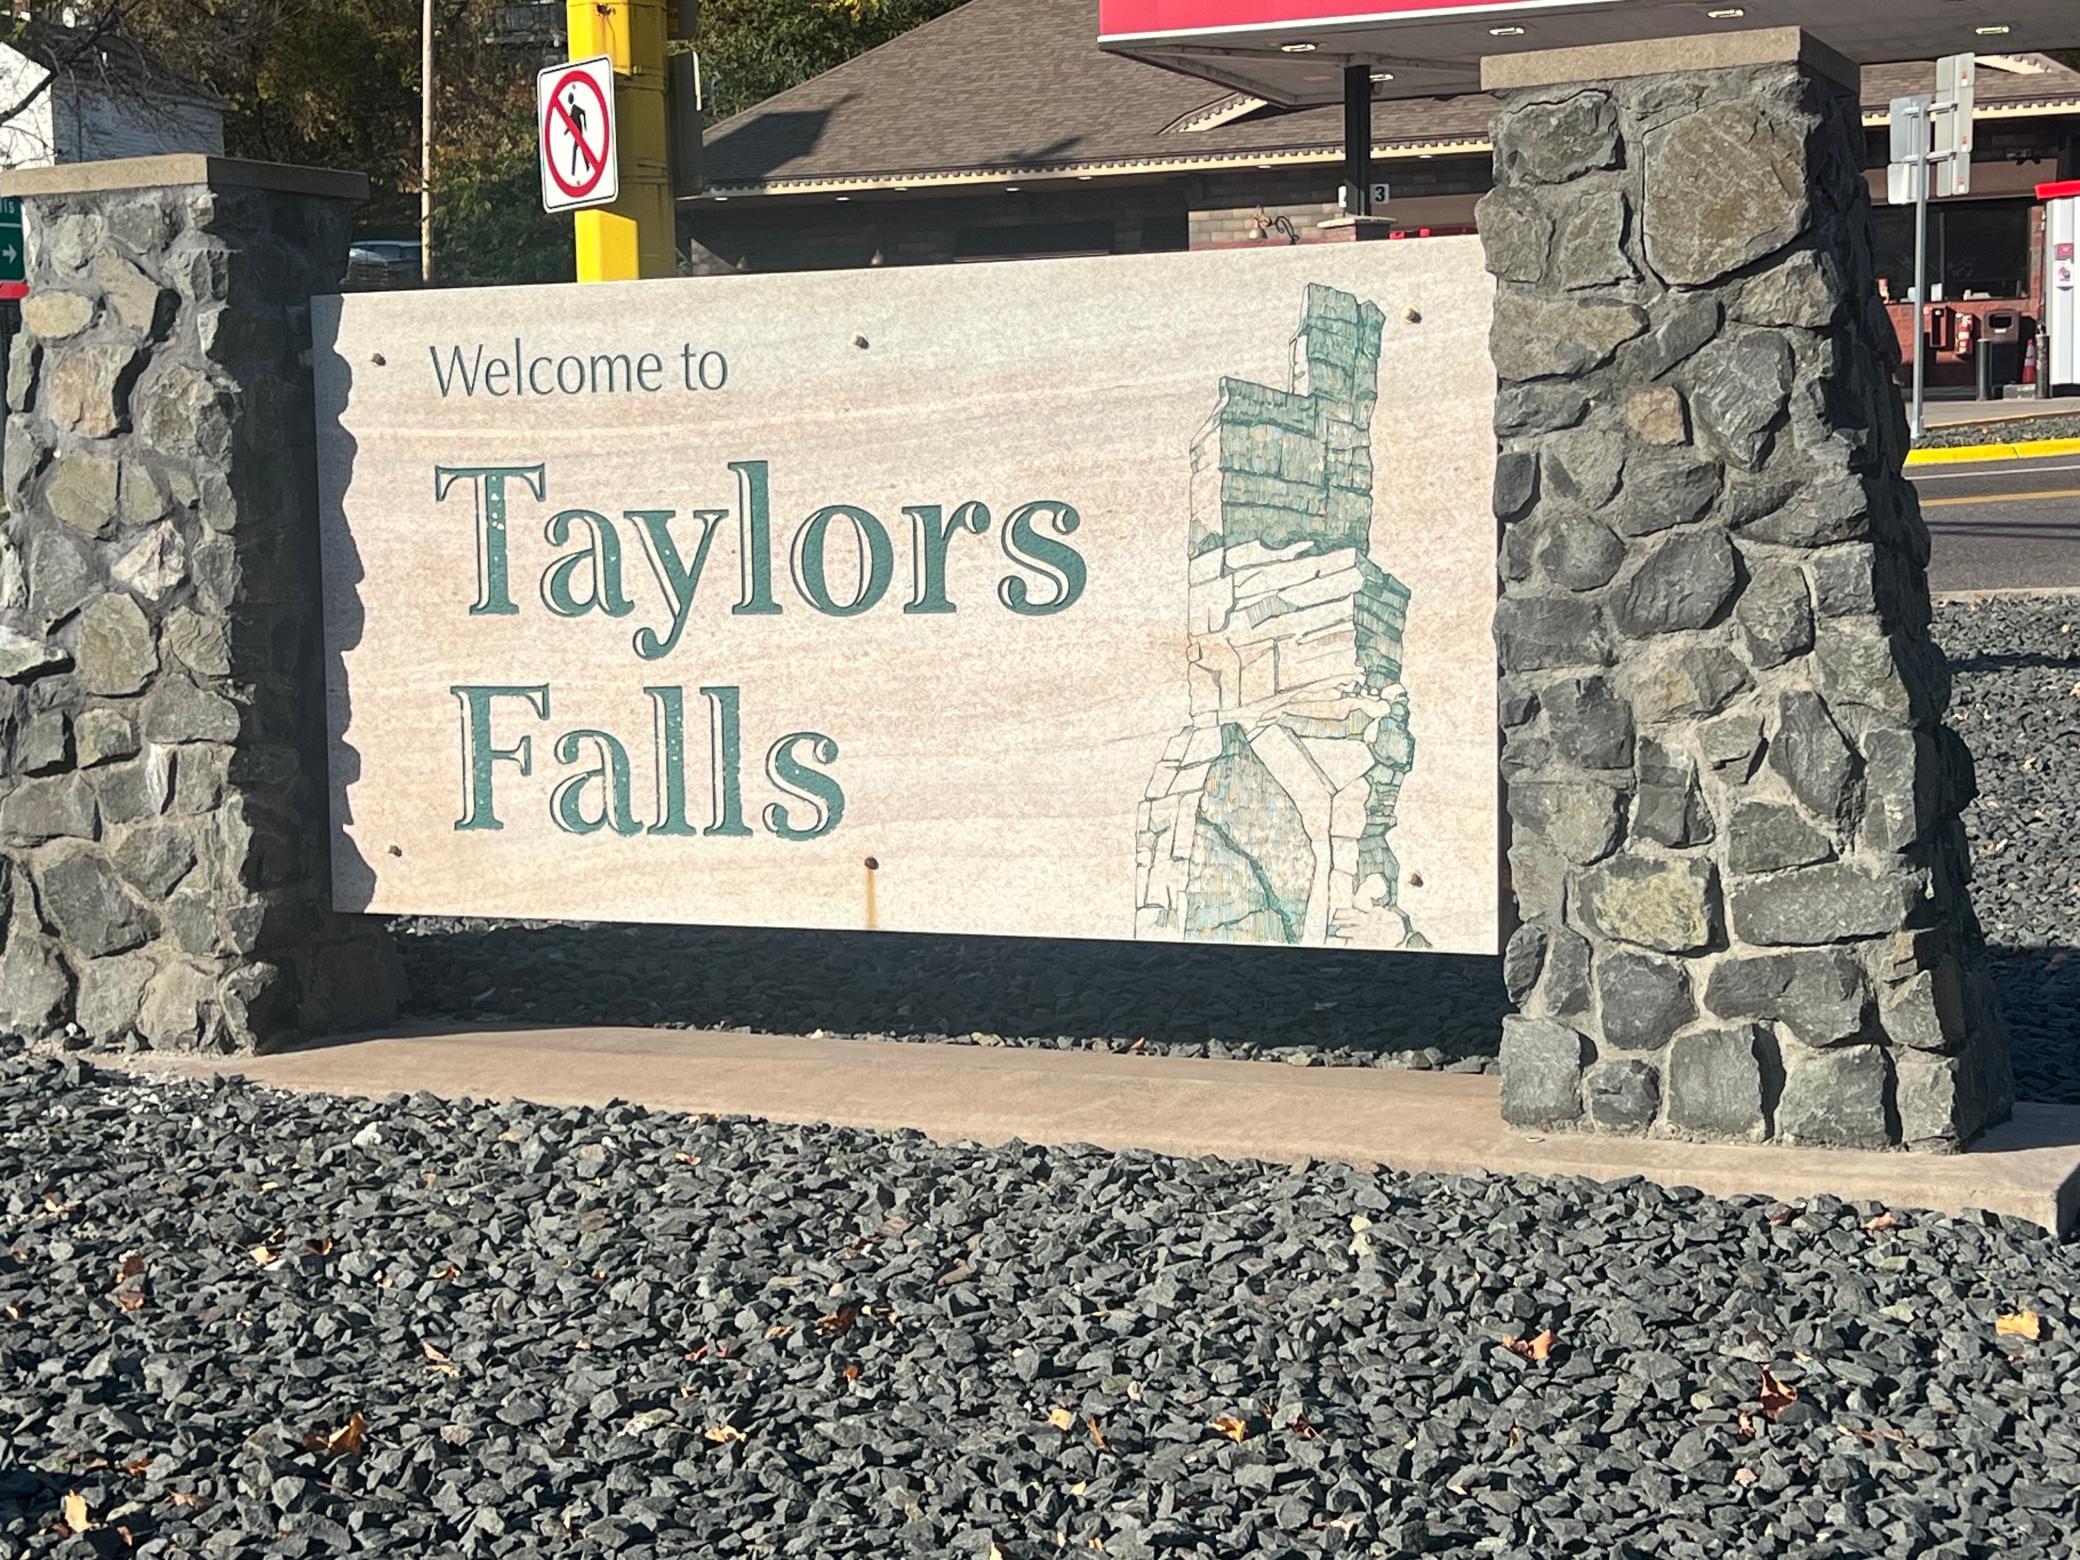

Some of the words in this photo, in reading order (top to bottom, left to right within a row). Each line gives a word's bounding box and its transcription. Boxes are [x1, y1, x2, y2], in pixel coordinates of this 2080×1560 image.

[1374, 185, 1386, 202] 3
[429, 337, 663, 398] Welcome
[680, 342, 728, 391] to
[434, 460, 1087, 660] Taylors
[449, 683, 846, 840] Falls
